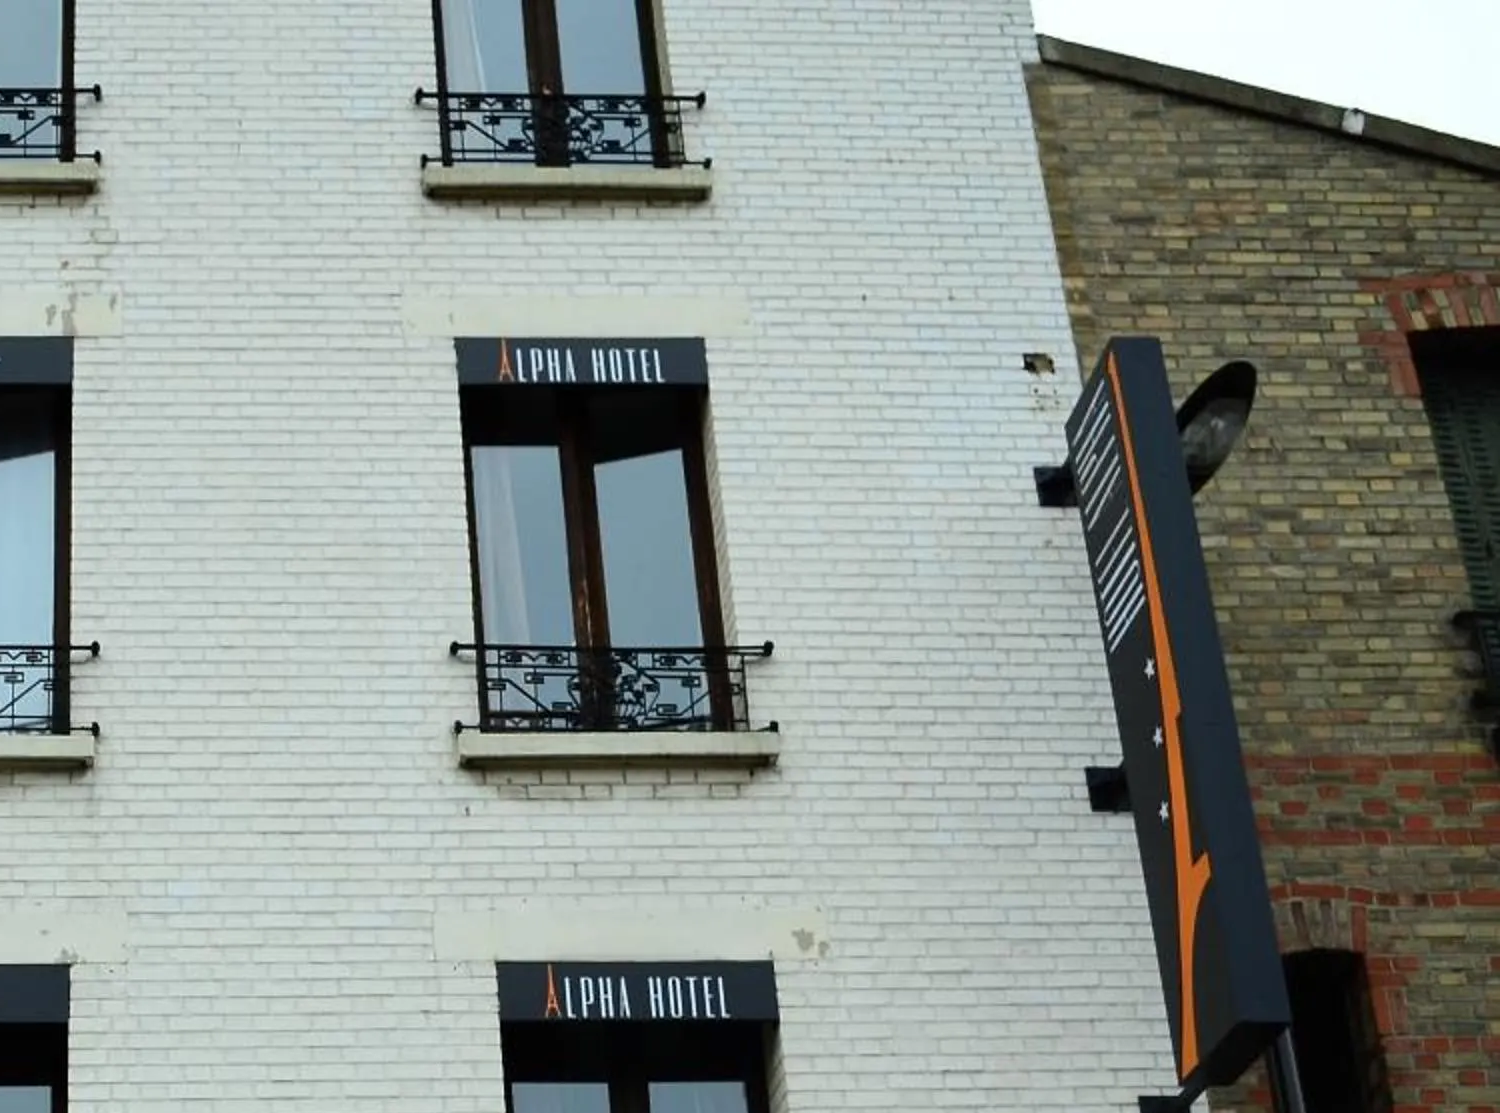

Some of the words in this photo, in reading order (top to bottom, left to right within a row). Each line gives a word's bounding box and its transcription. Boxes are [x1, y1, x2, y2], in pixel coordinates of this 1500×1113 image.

[499, 338, 577, 383] ALPHA
[590, 347, 666, 383] HOTEL
[545, 964, 632, 1019] ALPHA
[647, 976, 731, 1019] HOTEL
